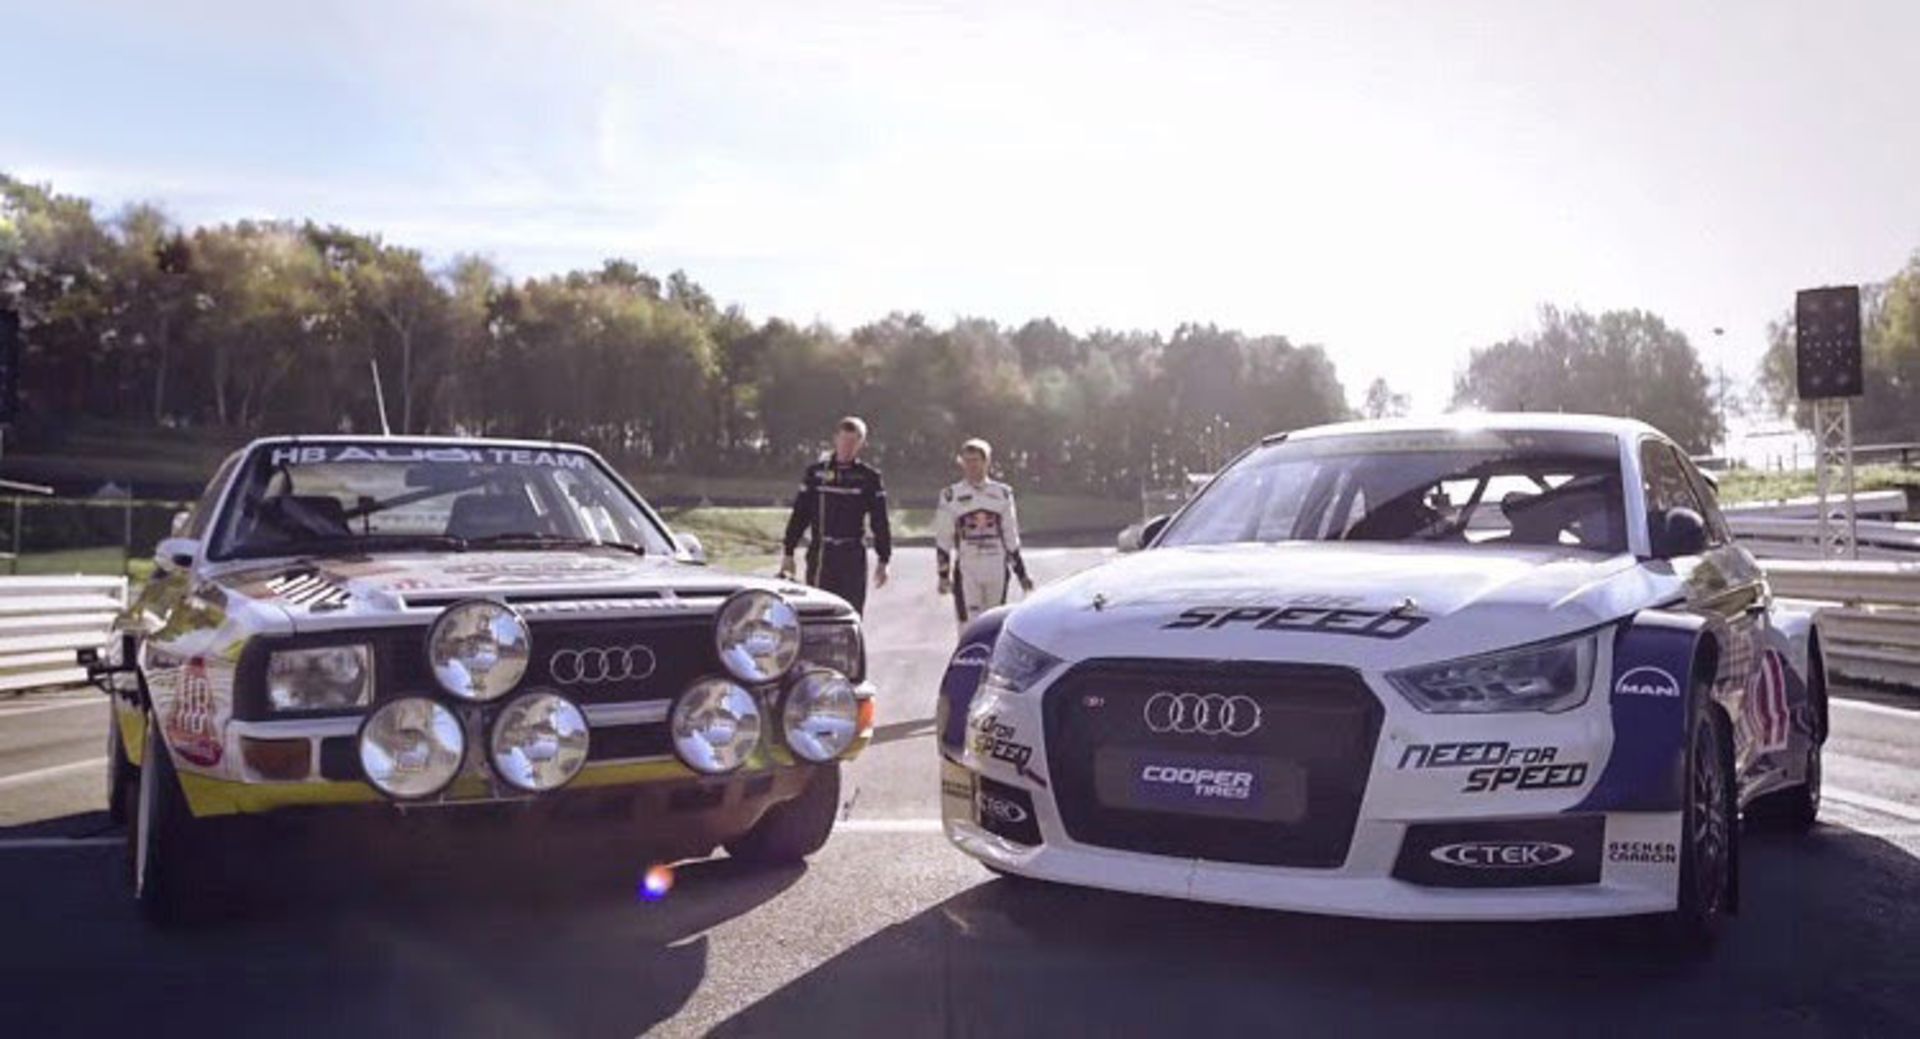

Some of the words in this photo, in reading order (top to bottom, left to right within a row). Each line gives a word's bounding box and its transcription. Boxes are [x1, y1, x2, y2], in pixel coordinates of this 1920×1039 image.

[272, 447, 326, 466] HB
[489, 450, 586, 469] TEAM
[1160, 605, 1430, 640] SPEED
[1621, 684, 1674, 695] MAN
[1397, 741, 1509, 769] NEED
[1504, 747, 1558, 764] FOR
[1142, 766, 1253, 787] COOPER
[1462, 763, 1588, 793] SPEED
[1195, 785, 1249, 799] TIRES
[1457, 845, 1540, 864] CTEK
